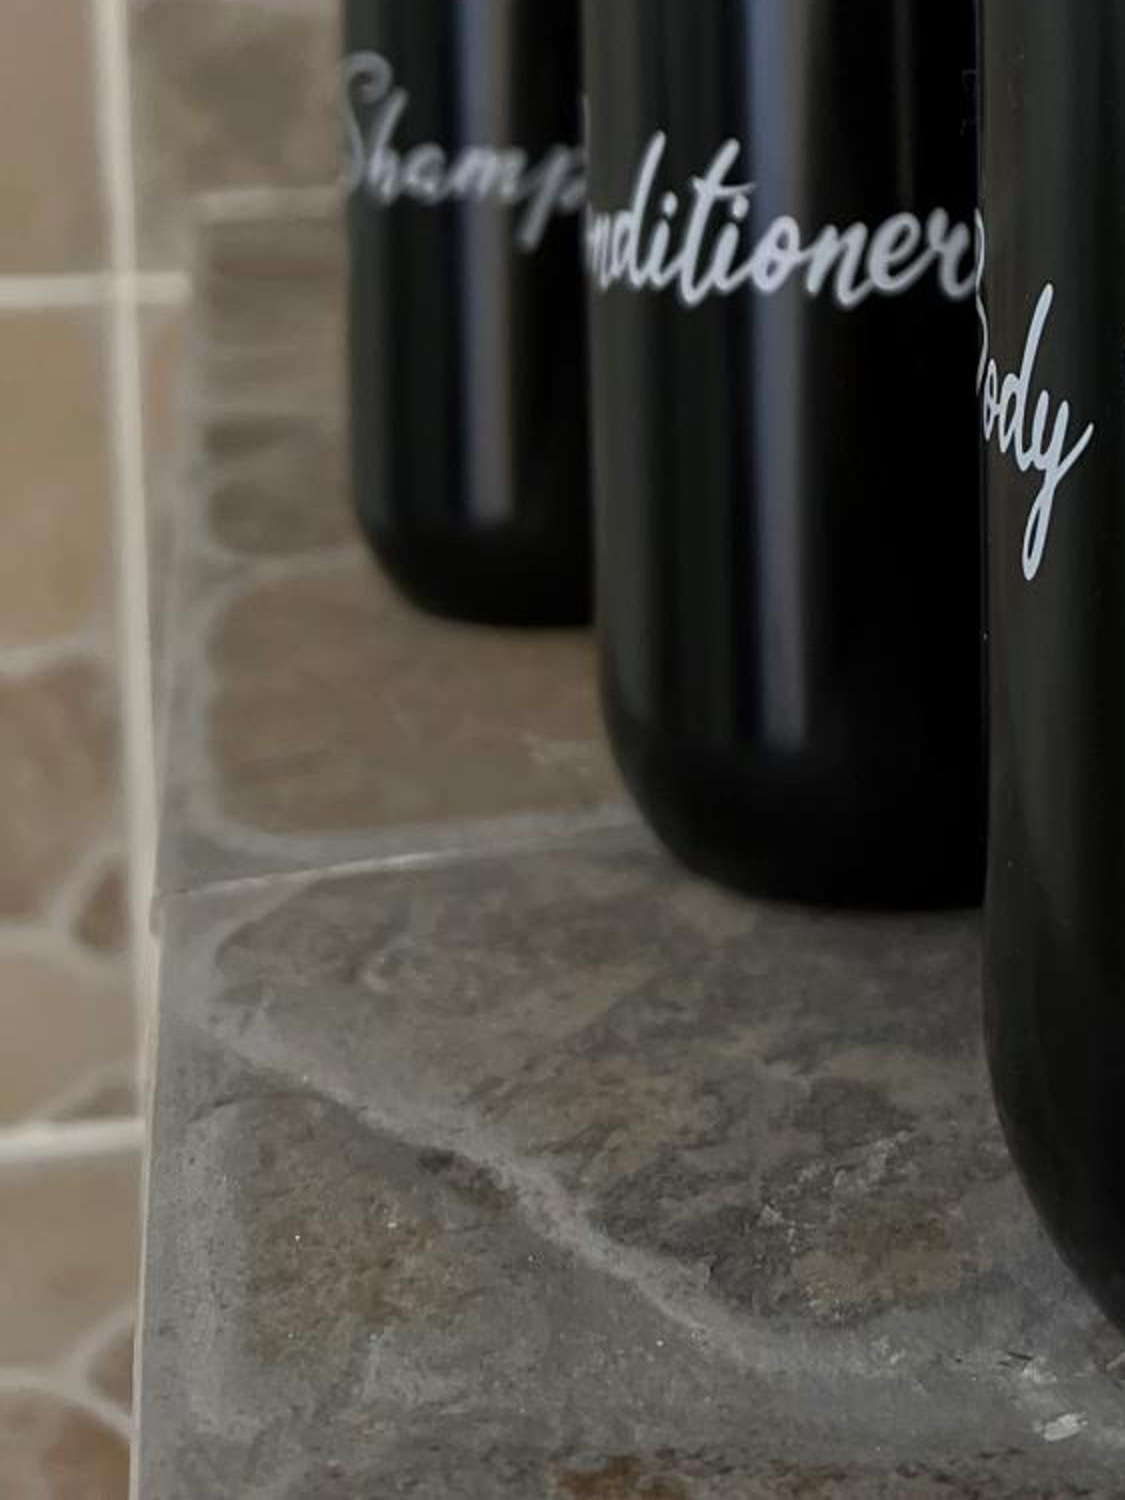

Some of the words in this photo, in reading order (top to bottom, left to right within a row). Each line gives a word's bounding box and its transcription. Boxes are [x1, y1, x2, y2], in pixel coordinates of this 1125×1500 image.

[340, 49, 588, 253] Shamp
[584, 128, 977, 308] nditioner
[975, 206, 1095, 582] ody
